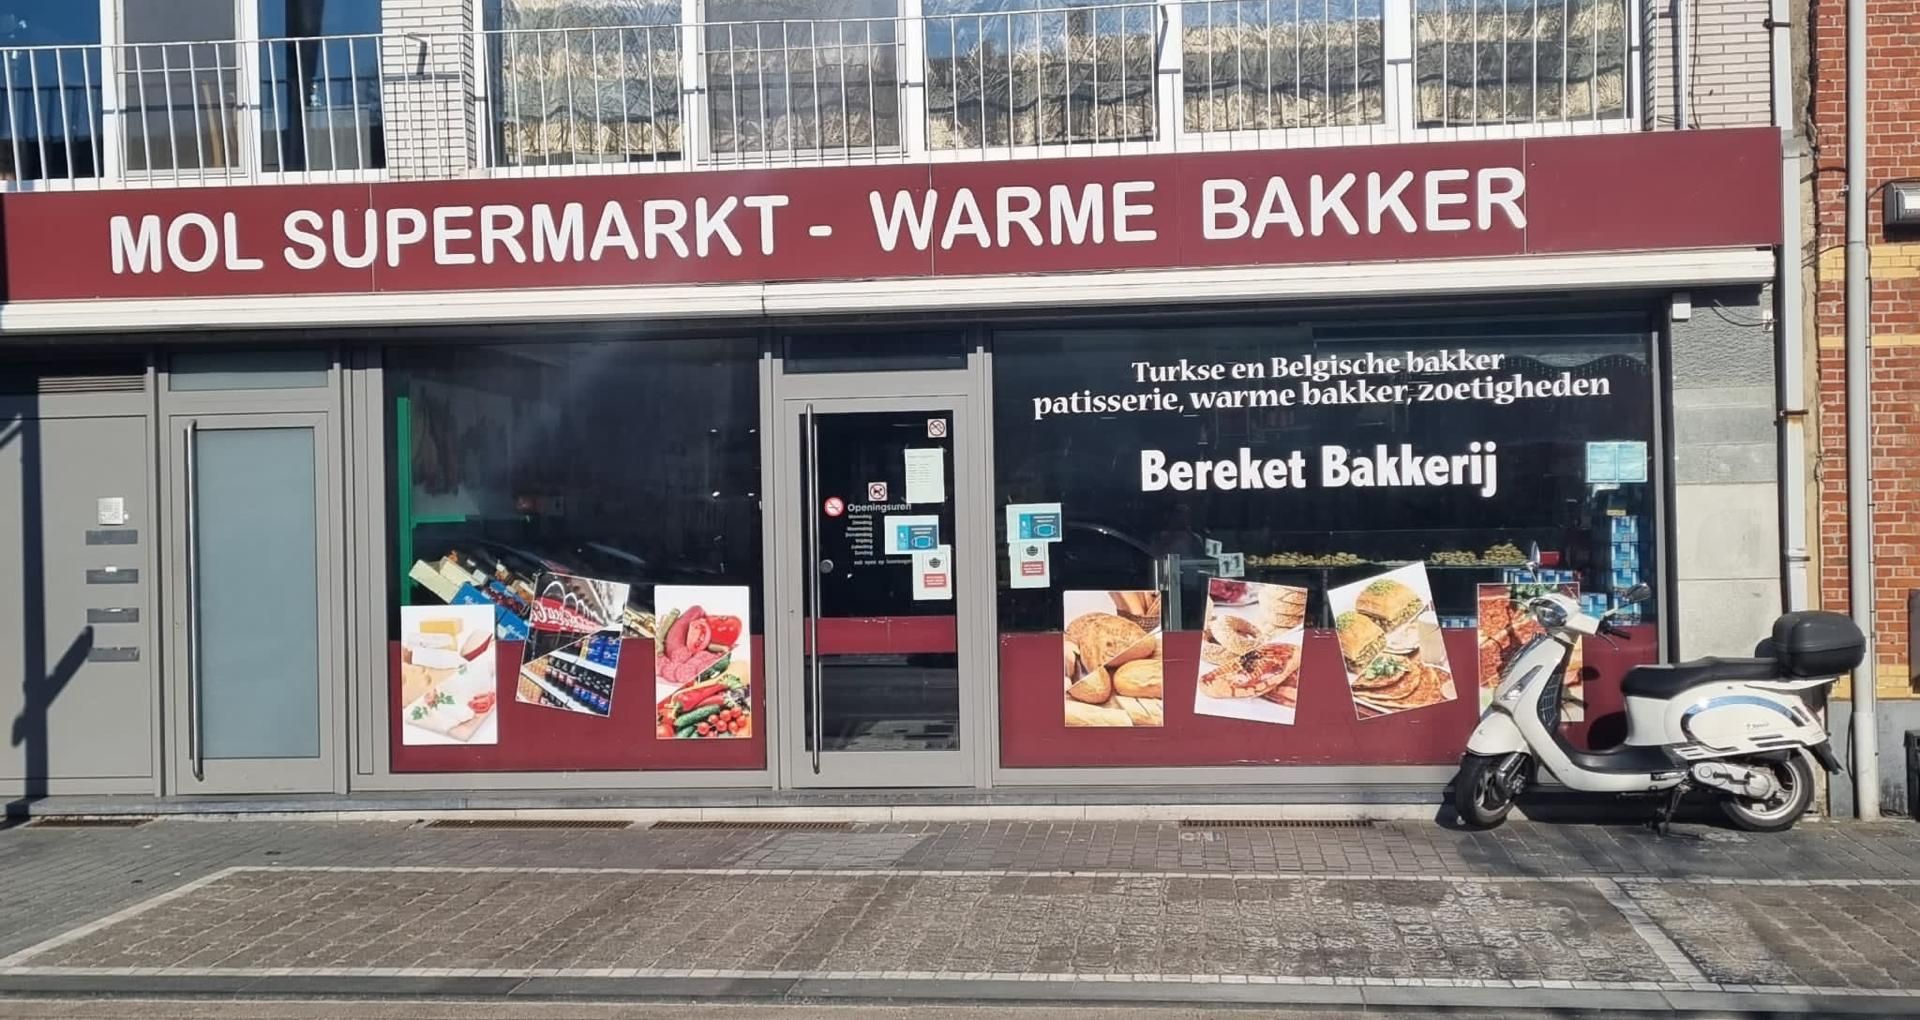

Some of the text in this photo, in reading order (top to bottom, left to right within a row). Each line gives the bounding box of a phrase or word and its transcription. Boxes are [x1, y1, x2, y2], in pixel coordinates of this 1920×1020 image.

[110, 167, 1528, 274] MOL SUPERMARKT - WARME BAKKER
[1131, 349, 1505, 383] Turkse en Belgische bakker
[1032, 372, 1611, 420] patisserie, warme bakker, zoetigheden
[1141, 441, 1497, 497] Bereket Bakkerij
[847, 503, 912, 513] Openingsuren
